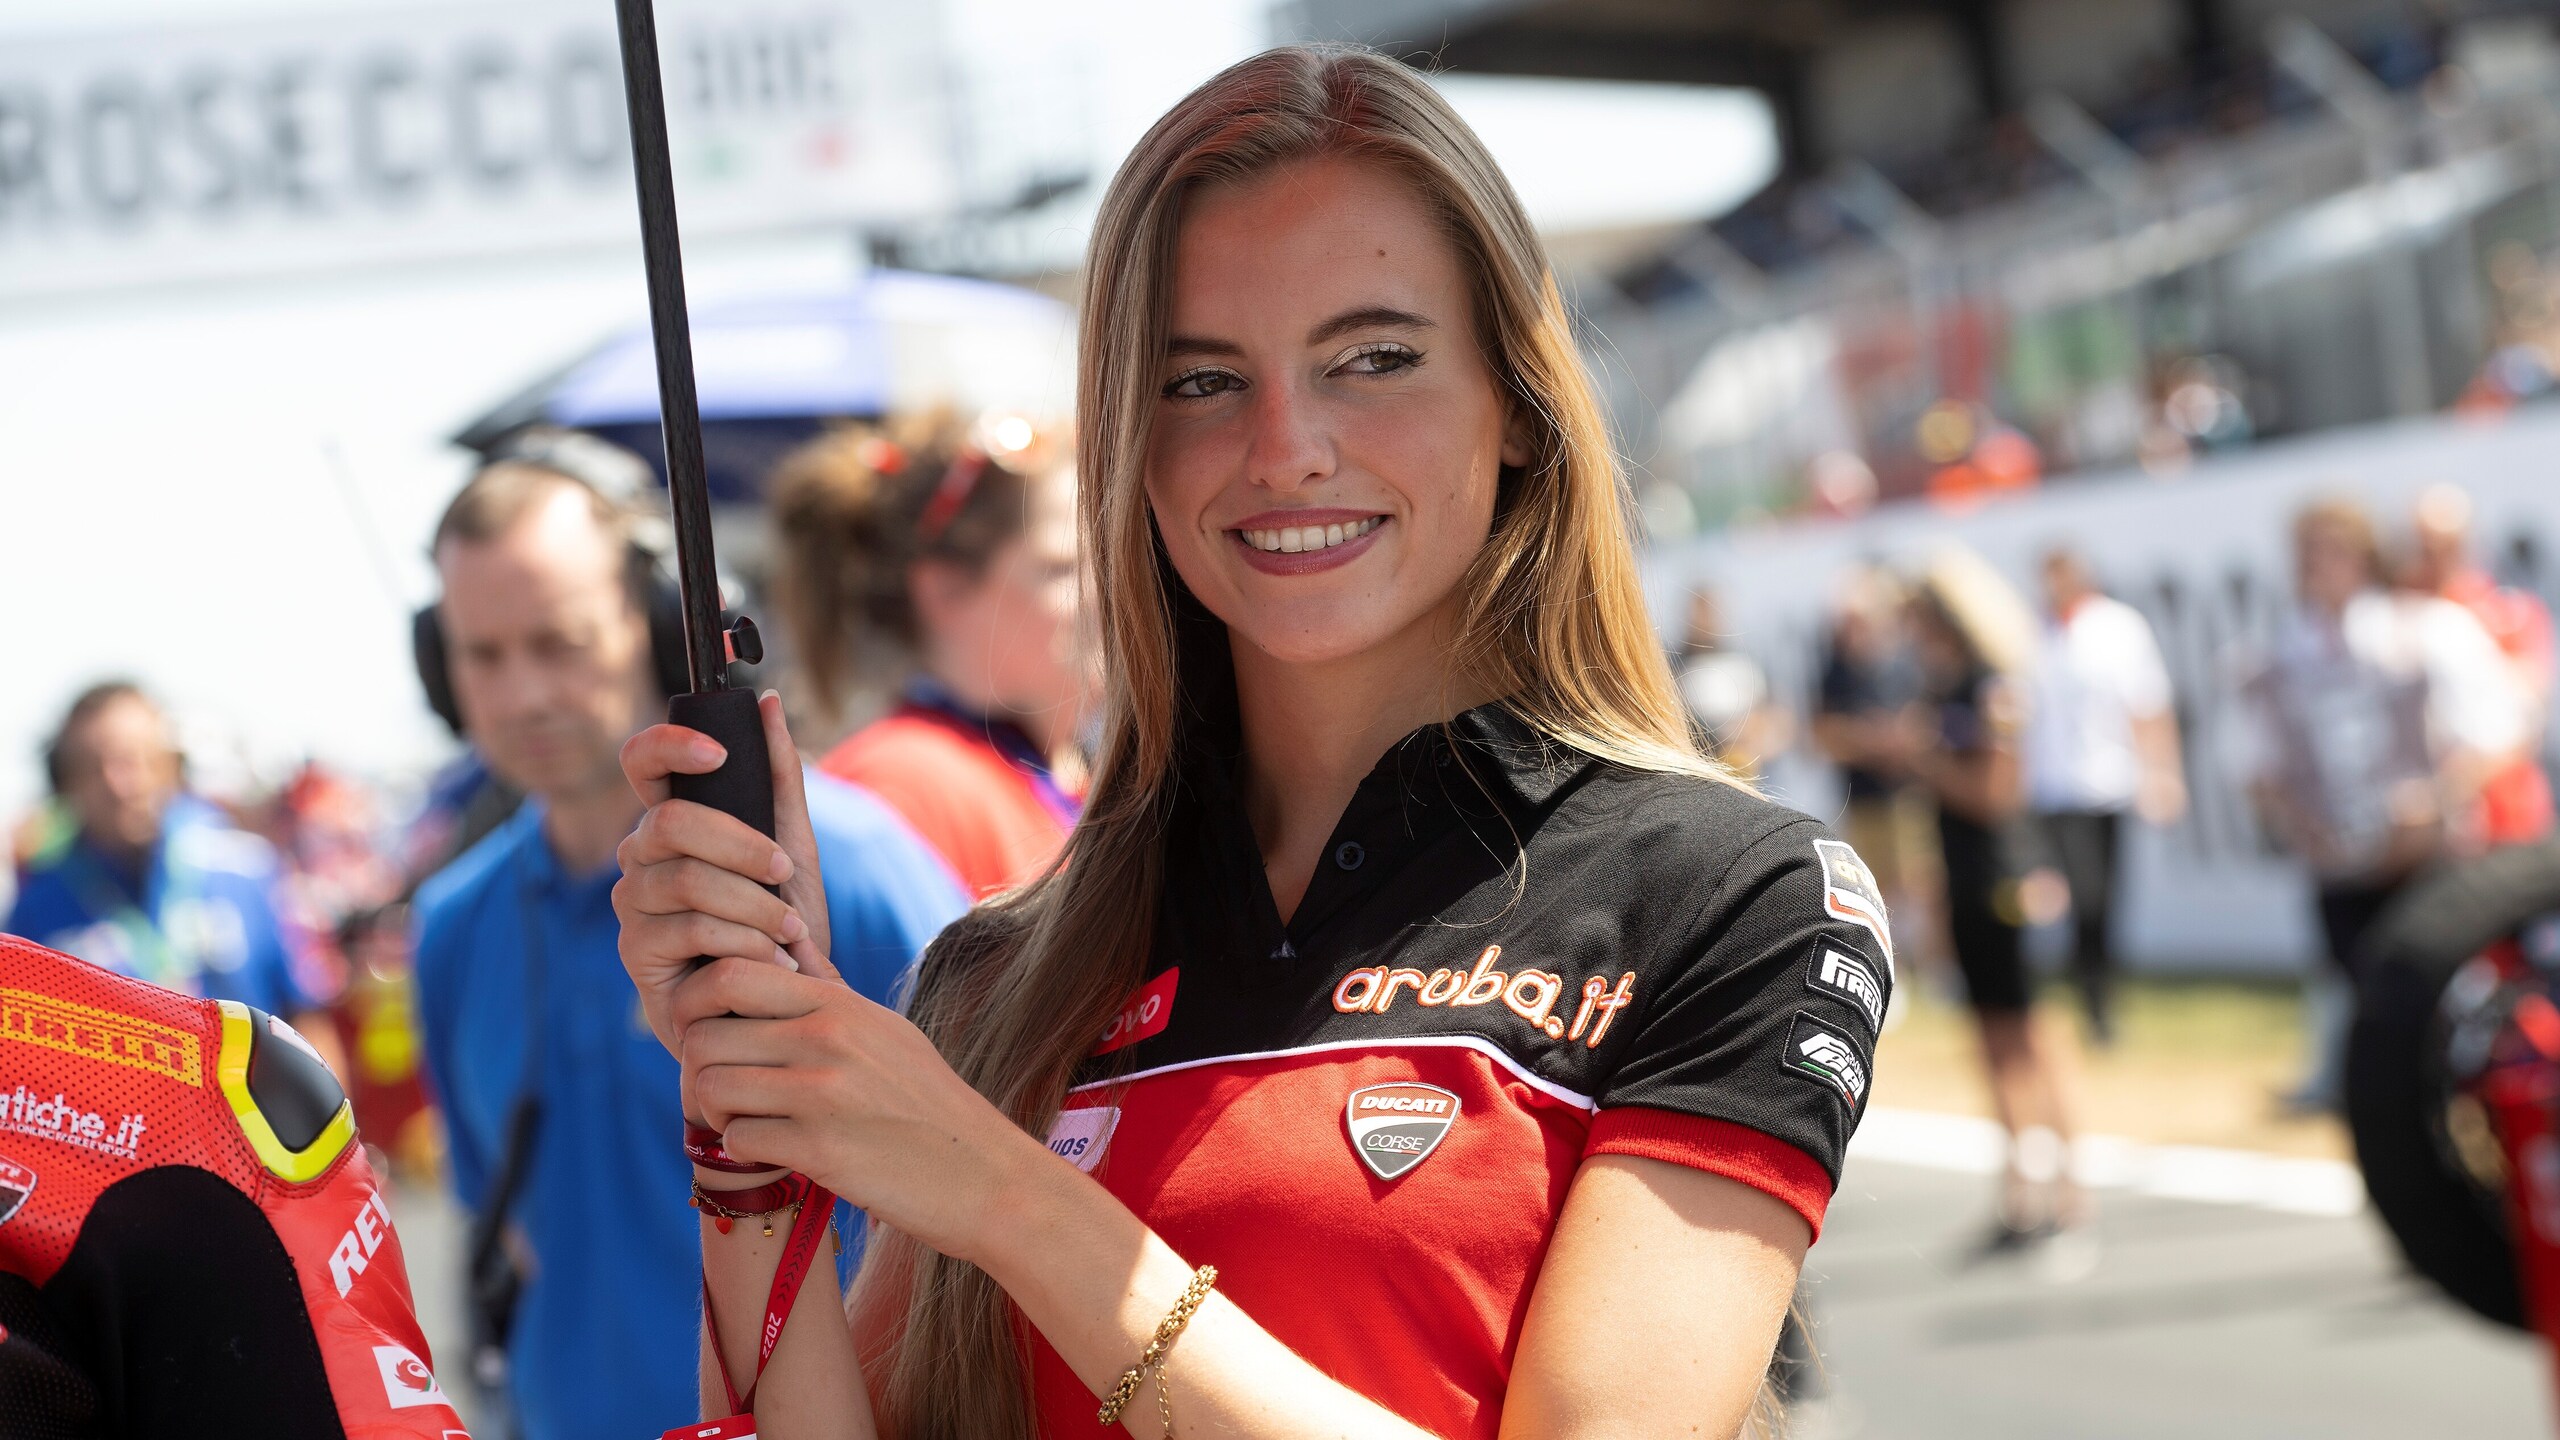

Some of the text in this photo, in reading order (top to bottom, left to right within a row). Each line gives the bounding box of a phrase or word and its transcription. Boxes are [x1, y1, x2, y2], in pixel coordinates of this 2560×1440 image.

[1101, 994, 1161, 1041] ovo
[1332, 945, 1637, 1048] aruba.it
[1360, 1096, 1448, 1114] DUCATI
[1366, 1134, 1425, 1151] CORSE
[762, 1312, 782, 1359] 2022
